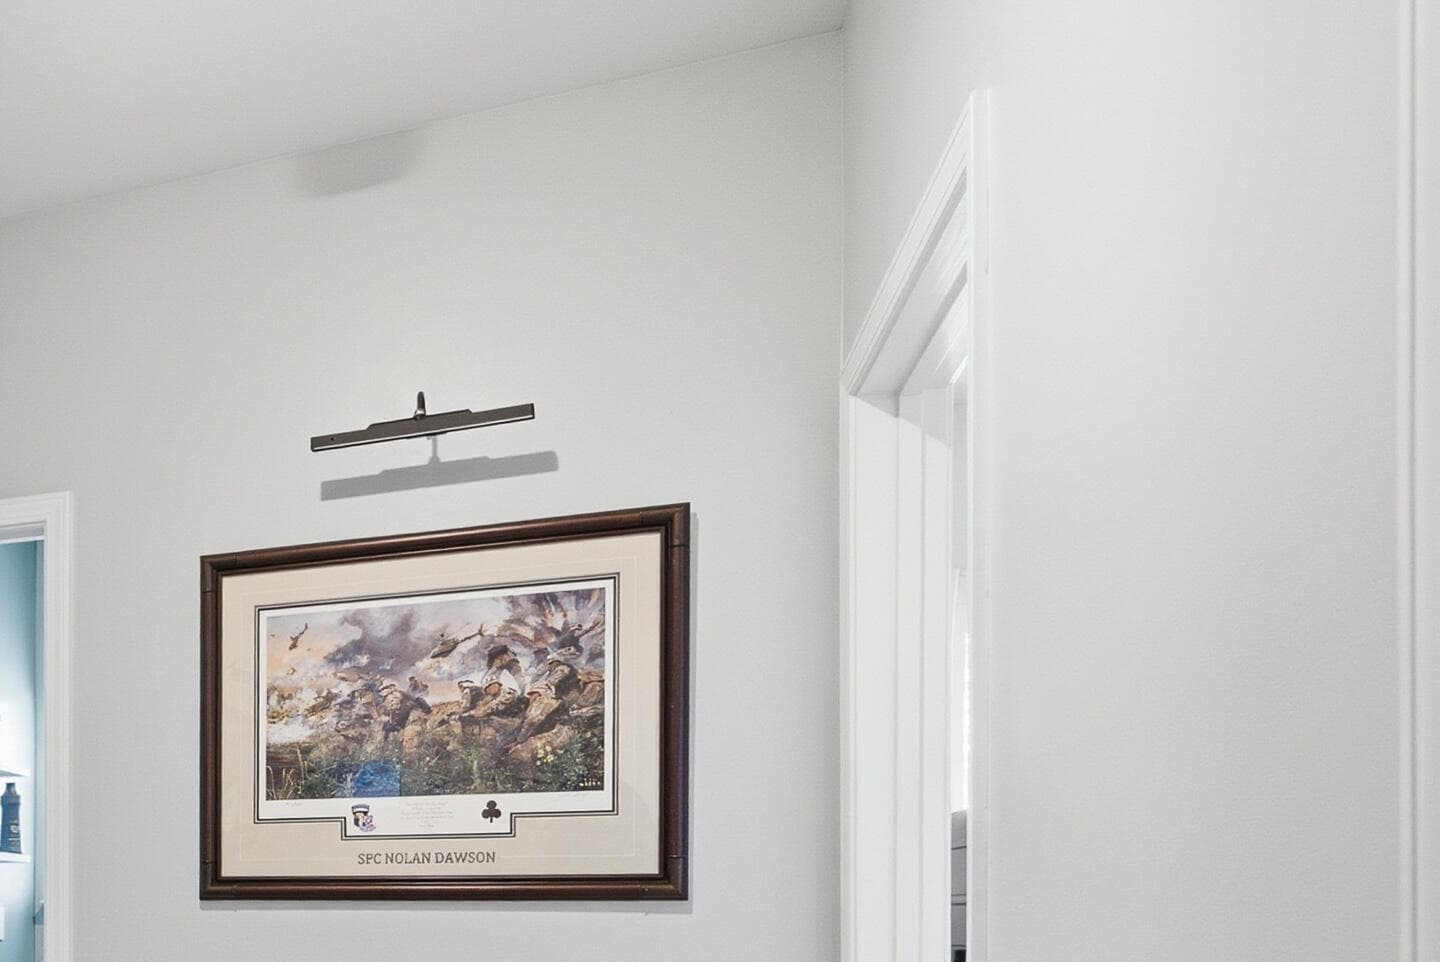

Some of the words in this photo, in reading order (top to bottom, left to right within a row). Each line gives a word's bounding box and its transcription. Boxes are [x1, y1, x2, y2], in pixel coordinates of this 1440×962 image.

[358, 853, 382, 865] SPC
[384, 852, 432, 865] NOLAN
[434, 851, 496, 864] DAWSON
